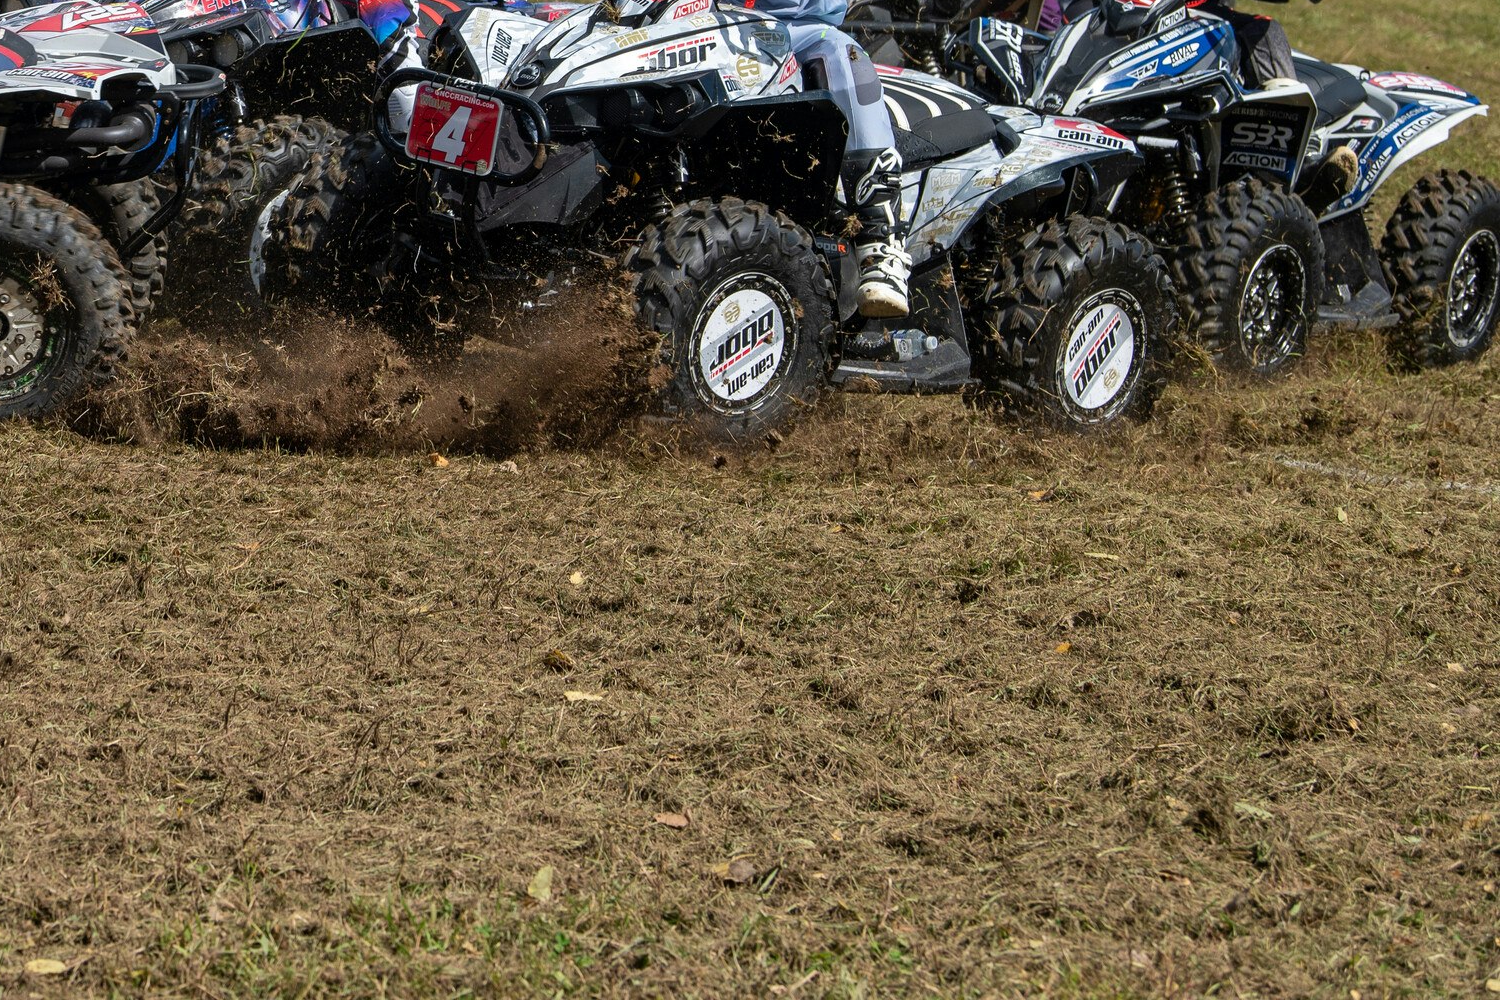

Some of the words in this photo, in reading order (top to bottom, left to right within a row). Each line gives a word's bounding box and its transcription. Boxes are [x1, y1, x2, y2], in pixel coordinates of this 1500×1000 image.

[60, 1, 140, 30] 327
[491, 27, 513, 67] can-am
[1168, 42, 1195, 64] RIVAL
[520, 73, 536, 81] BRP
[431, 104, 473, 164] 4
[1057, 128, 1125, 149] can-am
[1365, 154, 1388, 186] RIVAL
[1068, 307, 1104, 362] can-am
[726, 352, 775, 397] can-am
